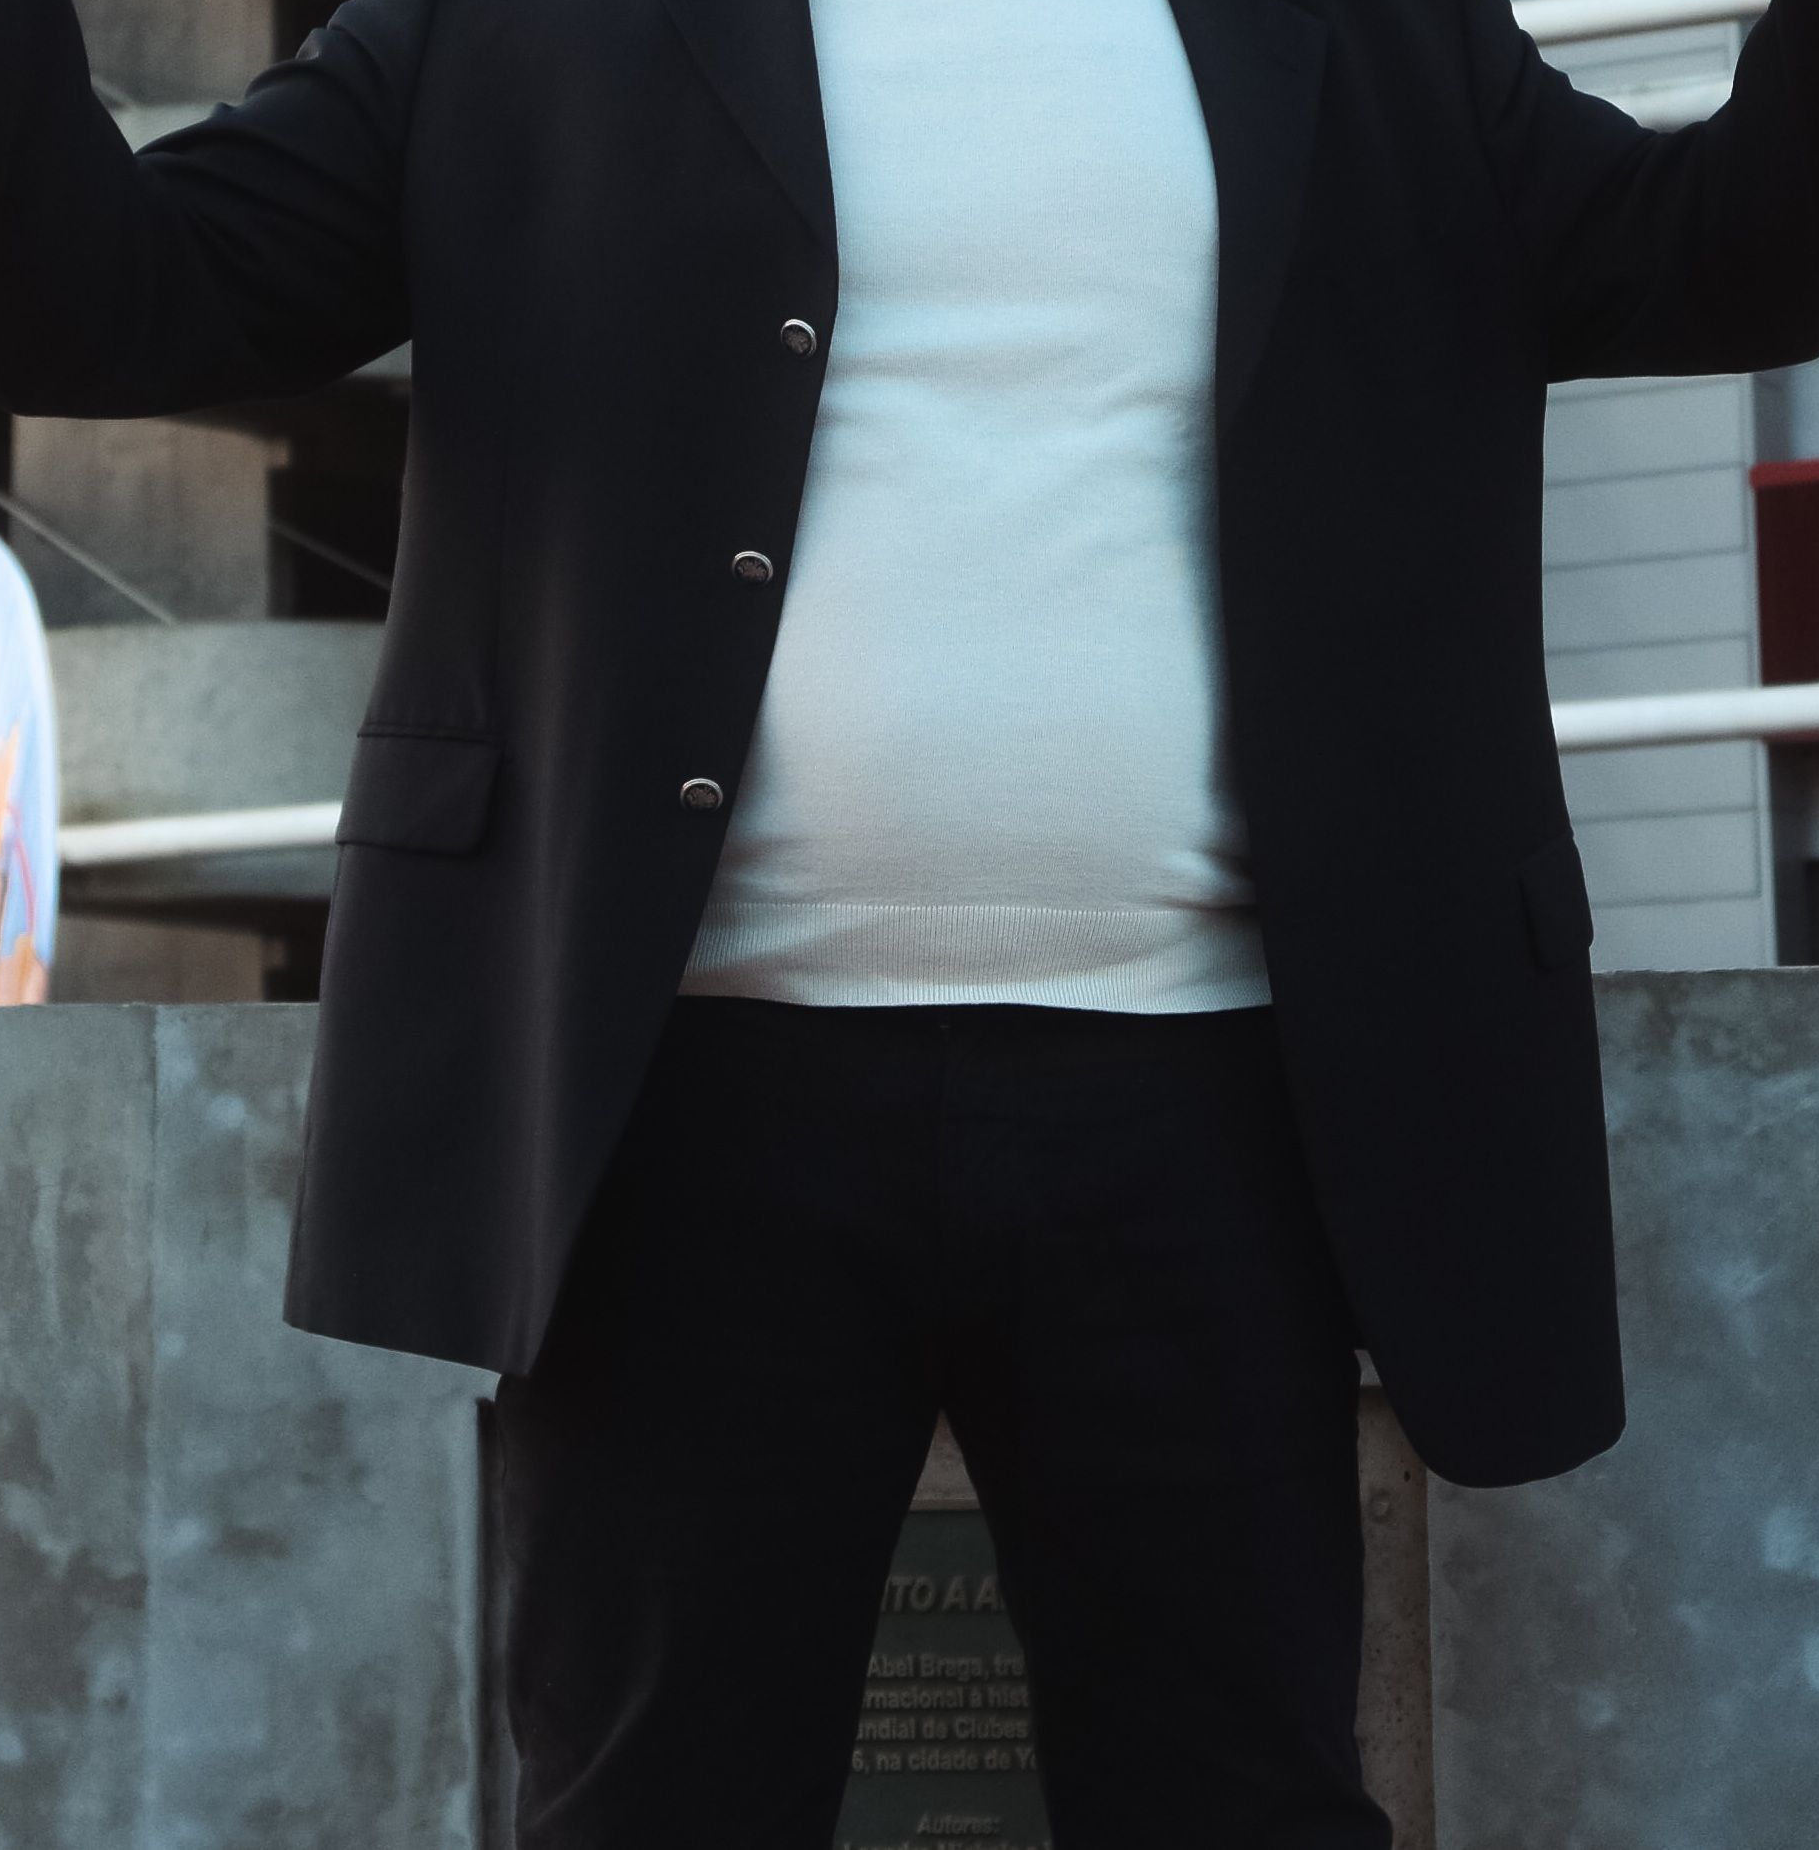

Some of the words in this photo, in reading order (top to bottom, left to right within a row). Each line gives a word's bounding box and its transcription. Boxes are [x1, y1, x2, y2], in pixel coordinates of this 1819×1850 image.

[941, 1575, 967, 1610] A
[972, 1575, 1005, 1610] A
[867, 1653, 915, 1677] Abel
[919, 1654, 989, 1682] Braga,
[922, 1717, 949, 1740] de
[953, 1715, 1028, 1740] Clubes
[876, 1752, 902, 1772] na
[907, 1747, 980, 1772] cidade
[984, 1748, 1012, 1772] de
